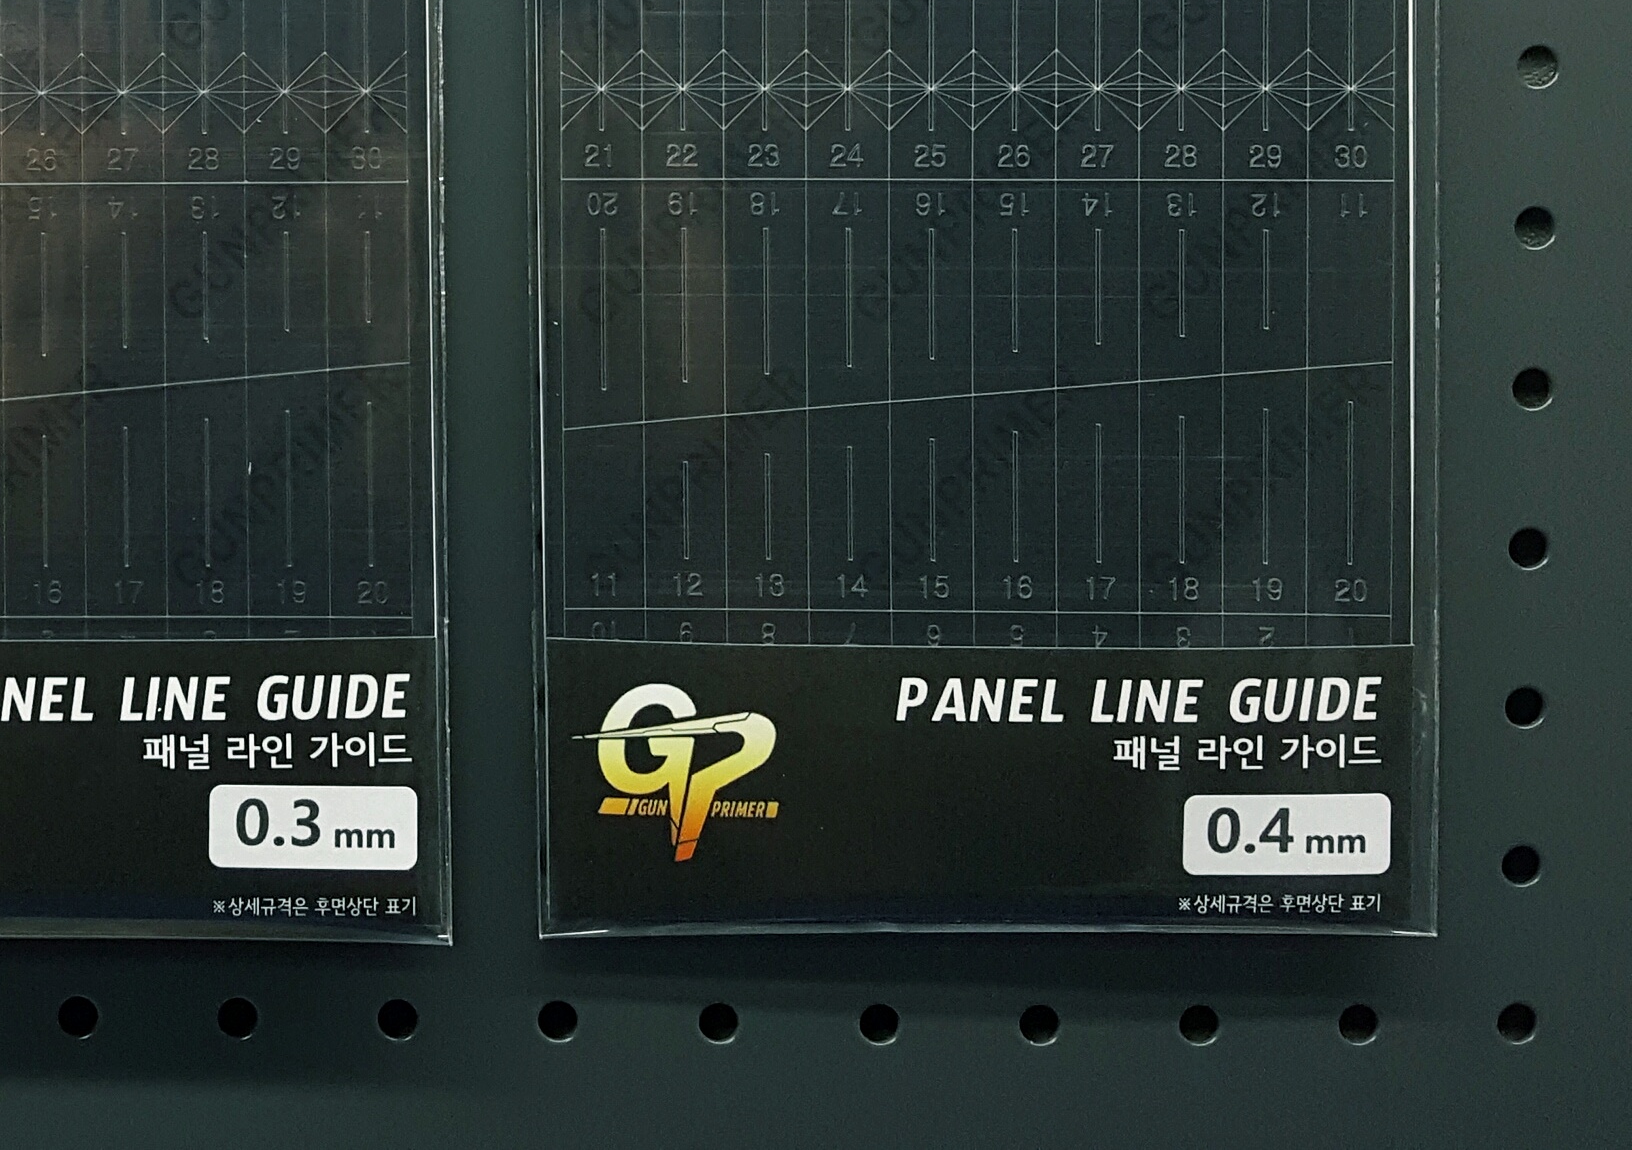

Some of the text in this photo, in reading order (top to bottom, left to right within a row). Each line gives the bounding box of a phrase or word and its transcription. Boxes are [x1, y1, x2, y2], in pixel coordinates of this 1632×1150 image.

[188, 147, 299, 170] 28 29
[585, 144, 1366, 168] 21 22 23 24 25 26 27 28 29 30
[588, 192, 1367, 217] 11 12 13 14 15 16 17 18 19 20
[592, 573, 1366, 602] 11 12 13 14 15 16 17 18 19 20
[120, 676, 230, 721] LINE
[257, 674, 410, 721] GUIDE
[895, 676, 1382, 724] PANEL LINE GUIDE
[143, 732, 412, 770] 패널 라인 가이드
[1113, 734, 1382, 771] 패널 라인 가이드
[236, 798, 394, 848] 0.3 mm
[638, 799, 765, 818] GUN PRIMER
[1208, 807, 1366, 854] 0.4 mm
[314, 897, 379, 916] 후면상단
[385, 897, 416, 916] 표기
[1280, 894, 1344, 912] 후면상단
[1350, 894, 1381, 912] 표기
